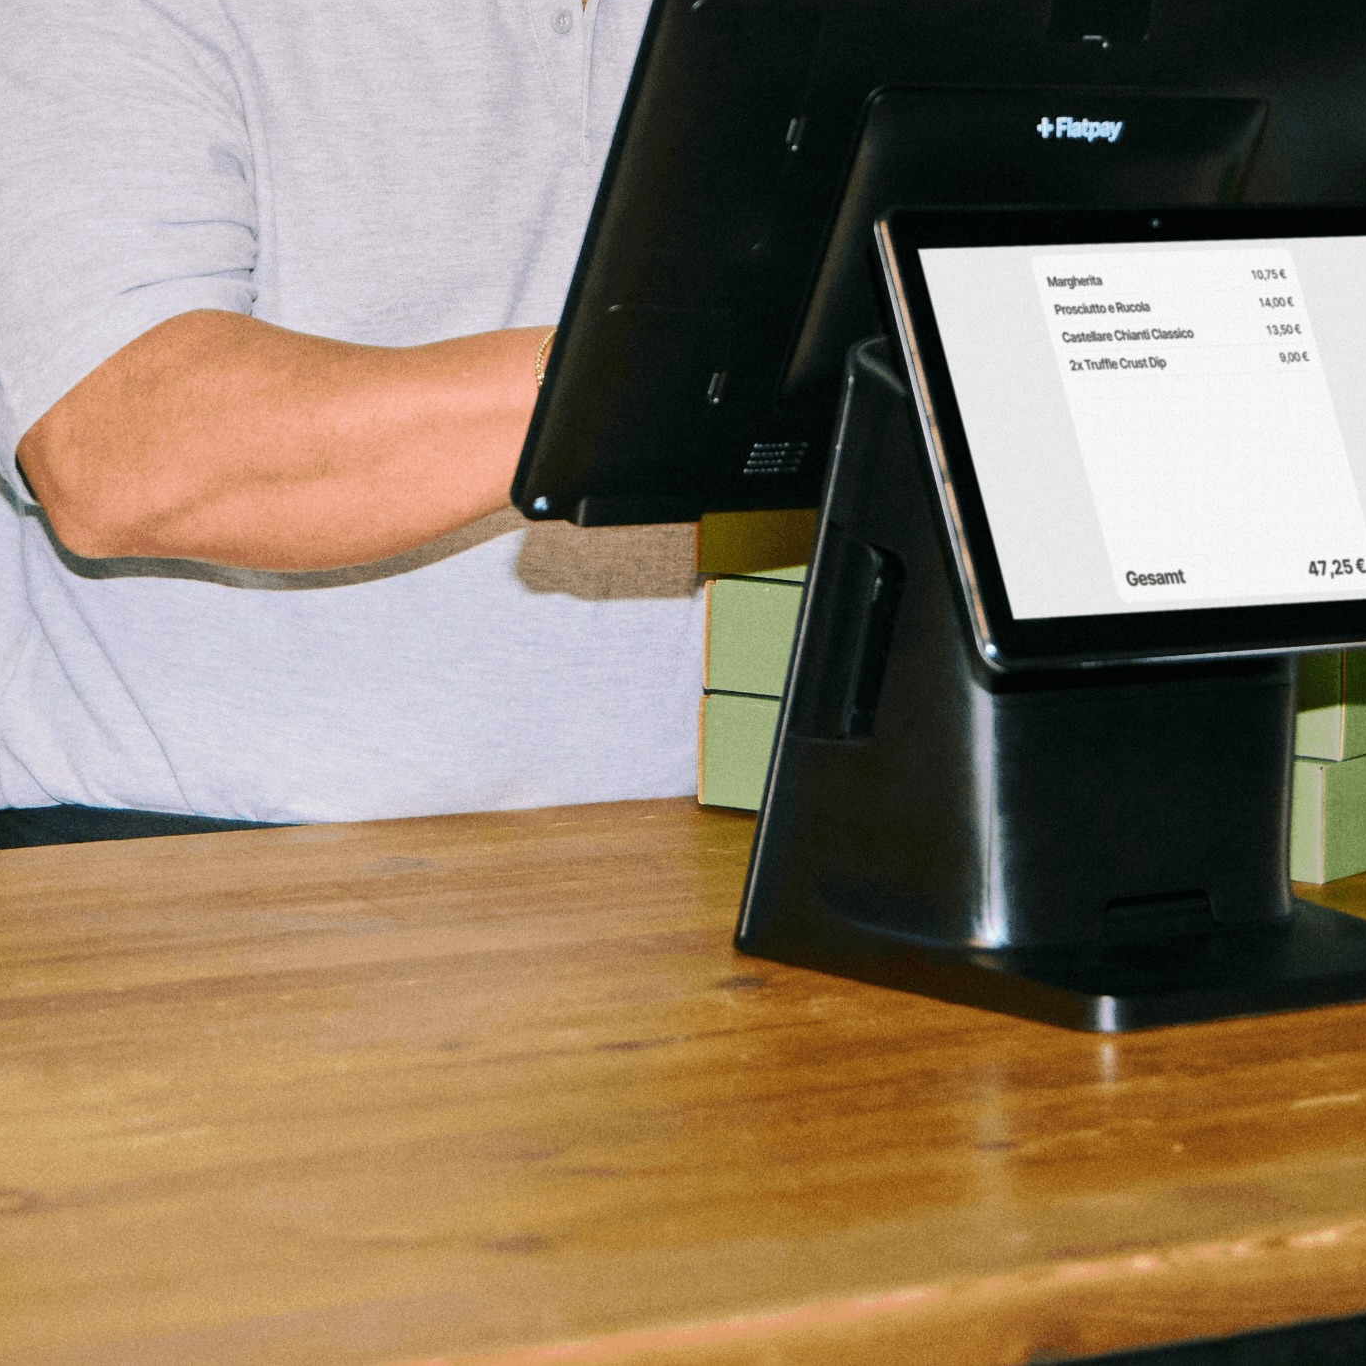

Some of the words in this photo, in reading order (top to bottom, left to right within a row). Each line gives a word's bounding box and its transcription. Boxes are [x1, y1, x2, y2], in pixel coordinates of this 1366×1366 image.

[1055, 116, 1123, 143] Flatpay
[1046, 275, 1103, 289] Margherita
[1251, 268, 1278, 282] 10,75
[1279, 268, 1287, 280] €
[1054, 303, 1107, 315] Prosciutto
[1108, 305, 1115, 314] e
[1115, 301, 1151, 314] Rucola
[1258, 296, 1286, 310] 14,00
[1286, 296, 1295, 308] €
[1061, 330, 1113, 343] Castellare
[1114, 328, 1151, 341] Chianti
[1151, 327, 1194, 340] Classico
[1266, 324, 1294, 337] 13,50
[1294, 323, 1302, 335] €
[1069, 359, 1084, 372] 2x
[1084, 358, 1118, 371] Truffle
[1119, 357, 1148, 370] Crust
[1148, 356, 1167, 370] Dip
[1278, 351, 1301, 365] 9,00
[1301, 350, 1310, 362] €
[1125, 569, 1187, 587] Gesamt
[1308, 559, 1354, 579] 47,25
